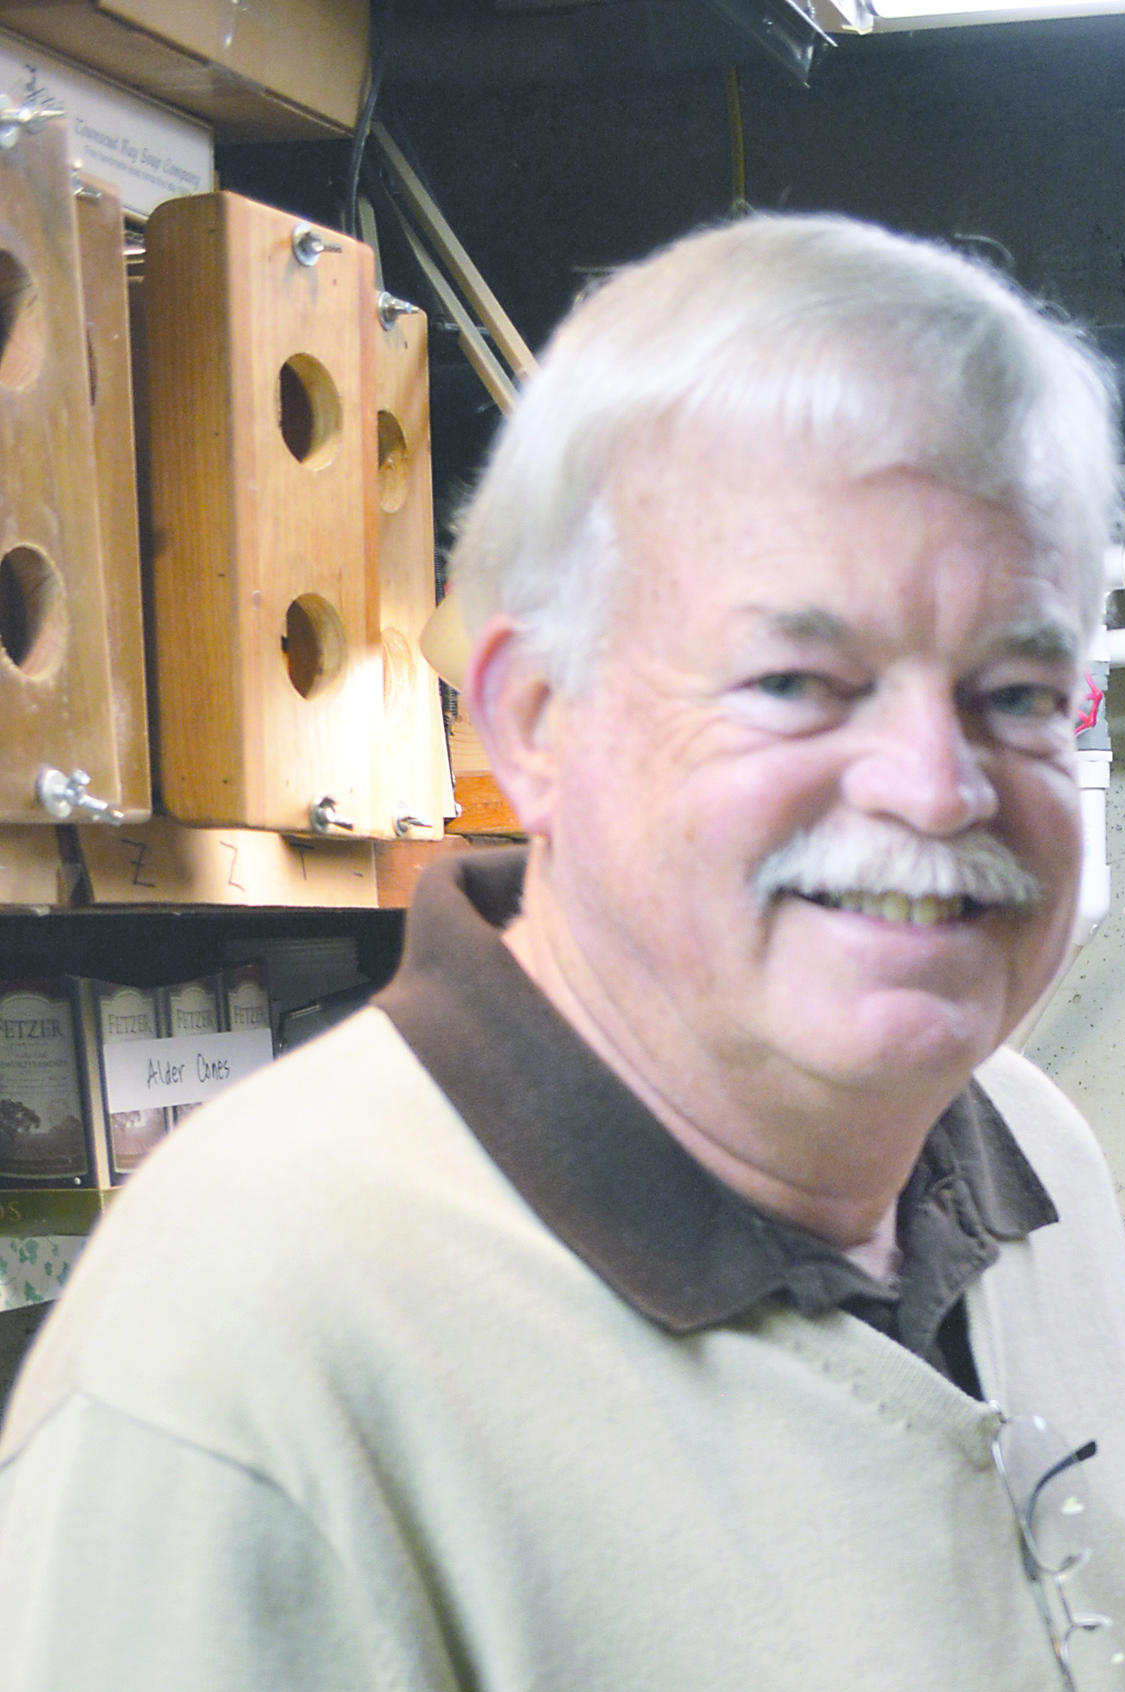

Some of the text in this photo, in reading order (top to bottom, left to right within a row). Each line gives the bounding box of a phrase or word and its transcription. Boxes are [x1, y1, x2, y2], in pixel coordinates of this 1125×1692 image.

[0, 1017, 63, 1039] ETZER
[108, 1013, 150, 1035] FETZER
[177, 1008, 215, 1030] FETZER
[147, 1053, 230, 1088] Alder Cones
